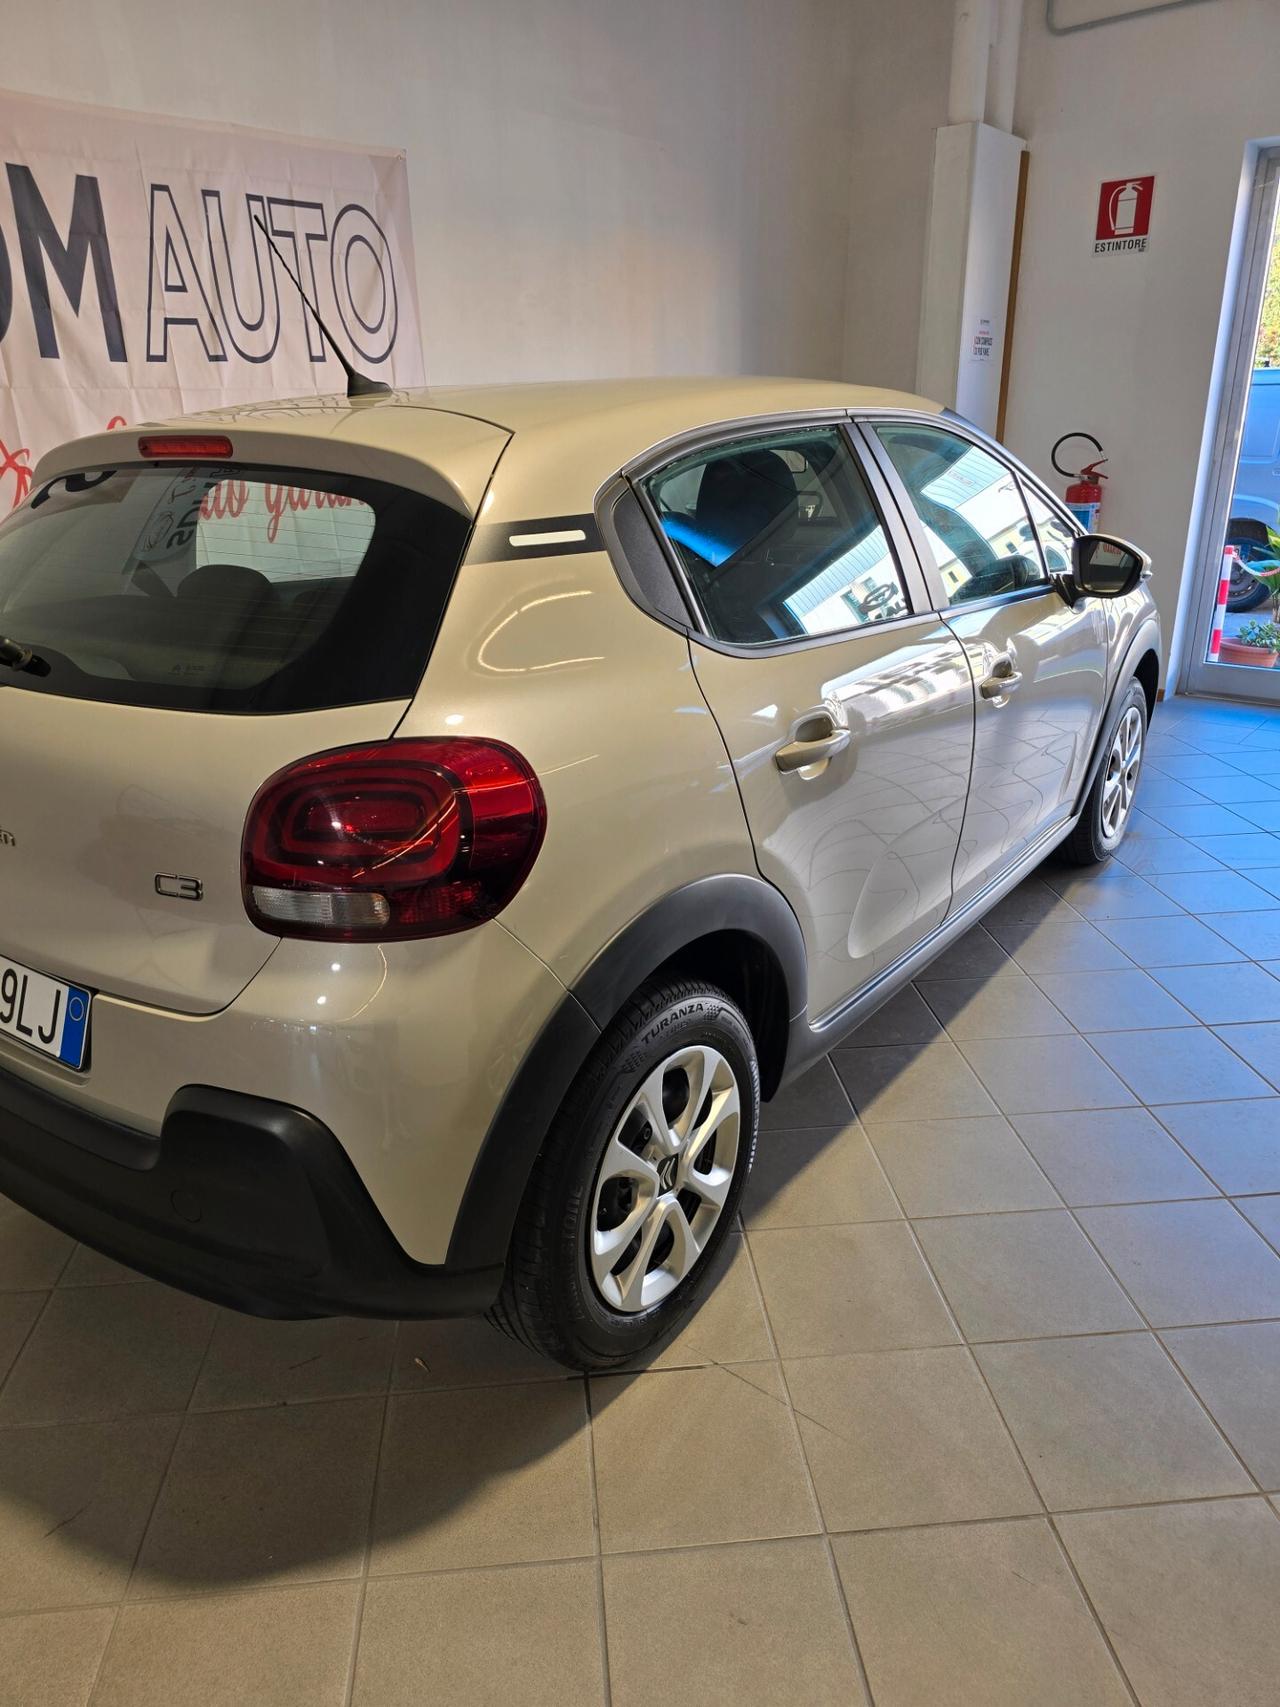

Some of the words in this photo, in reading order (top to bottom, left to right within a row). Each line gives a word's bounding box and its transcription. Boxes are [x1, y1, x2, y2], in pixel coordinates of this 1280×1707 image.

[0, 162, 127, 363] M
[146, 184, 399, 363] AUTO
[1094, 238, 1147, 253] ESTINTORE
[154, 872, 203, 901] C3
[0, 968, 61, 1044] 9LJ
[641, 1003, 704, 1044] TURANZA
